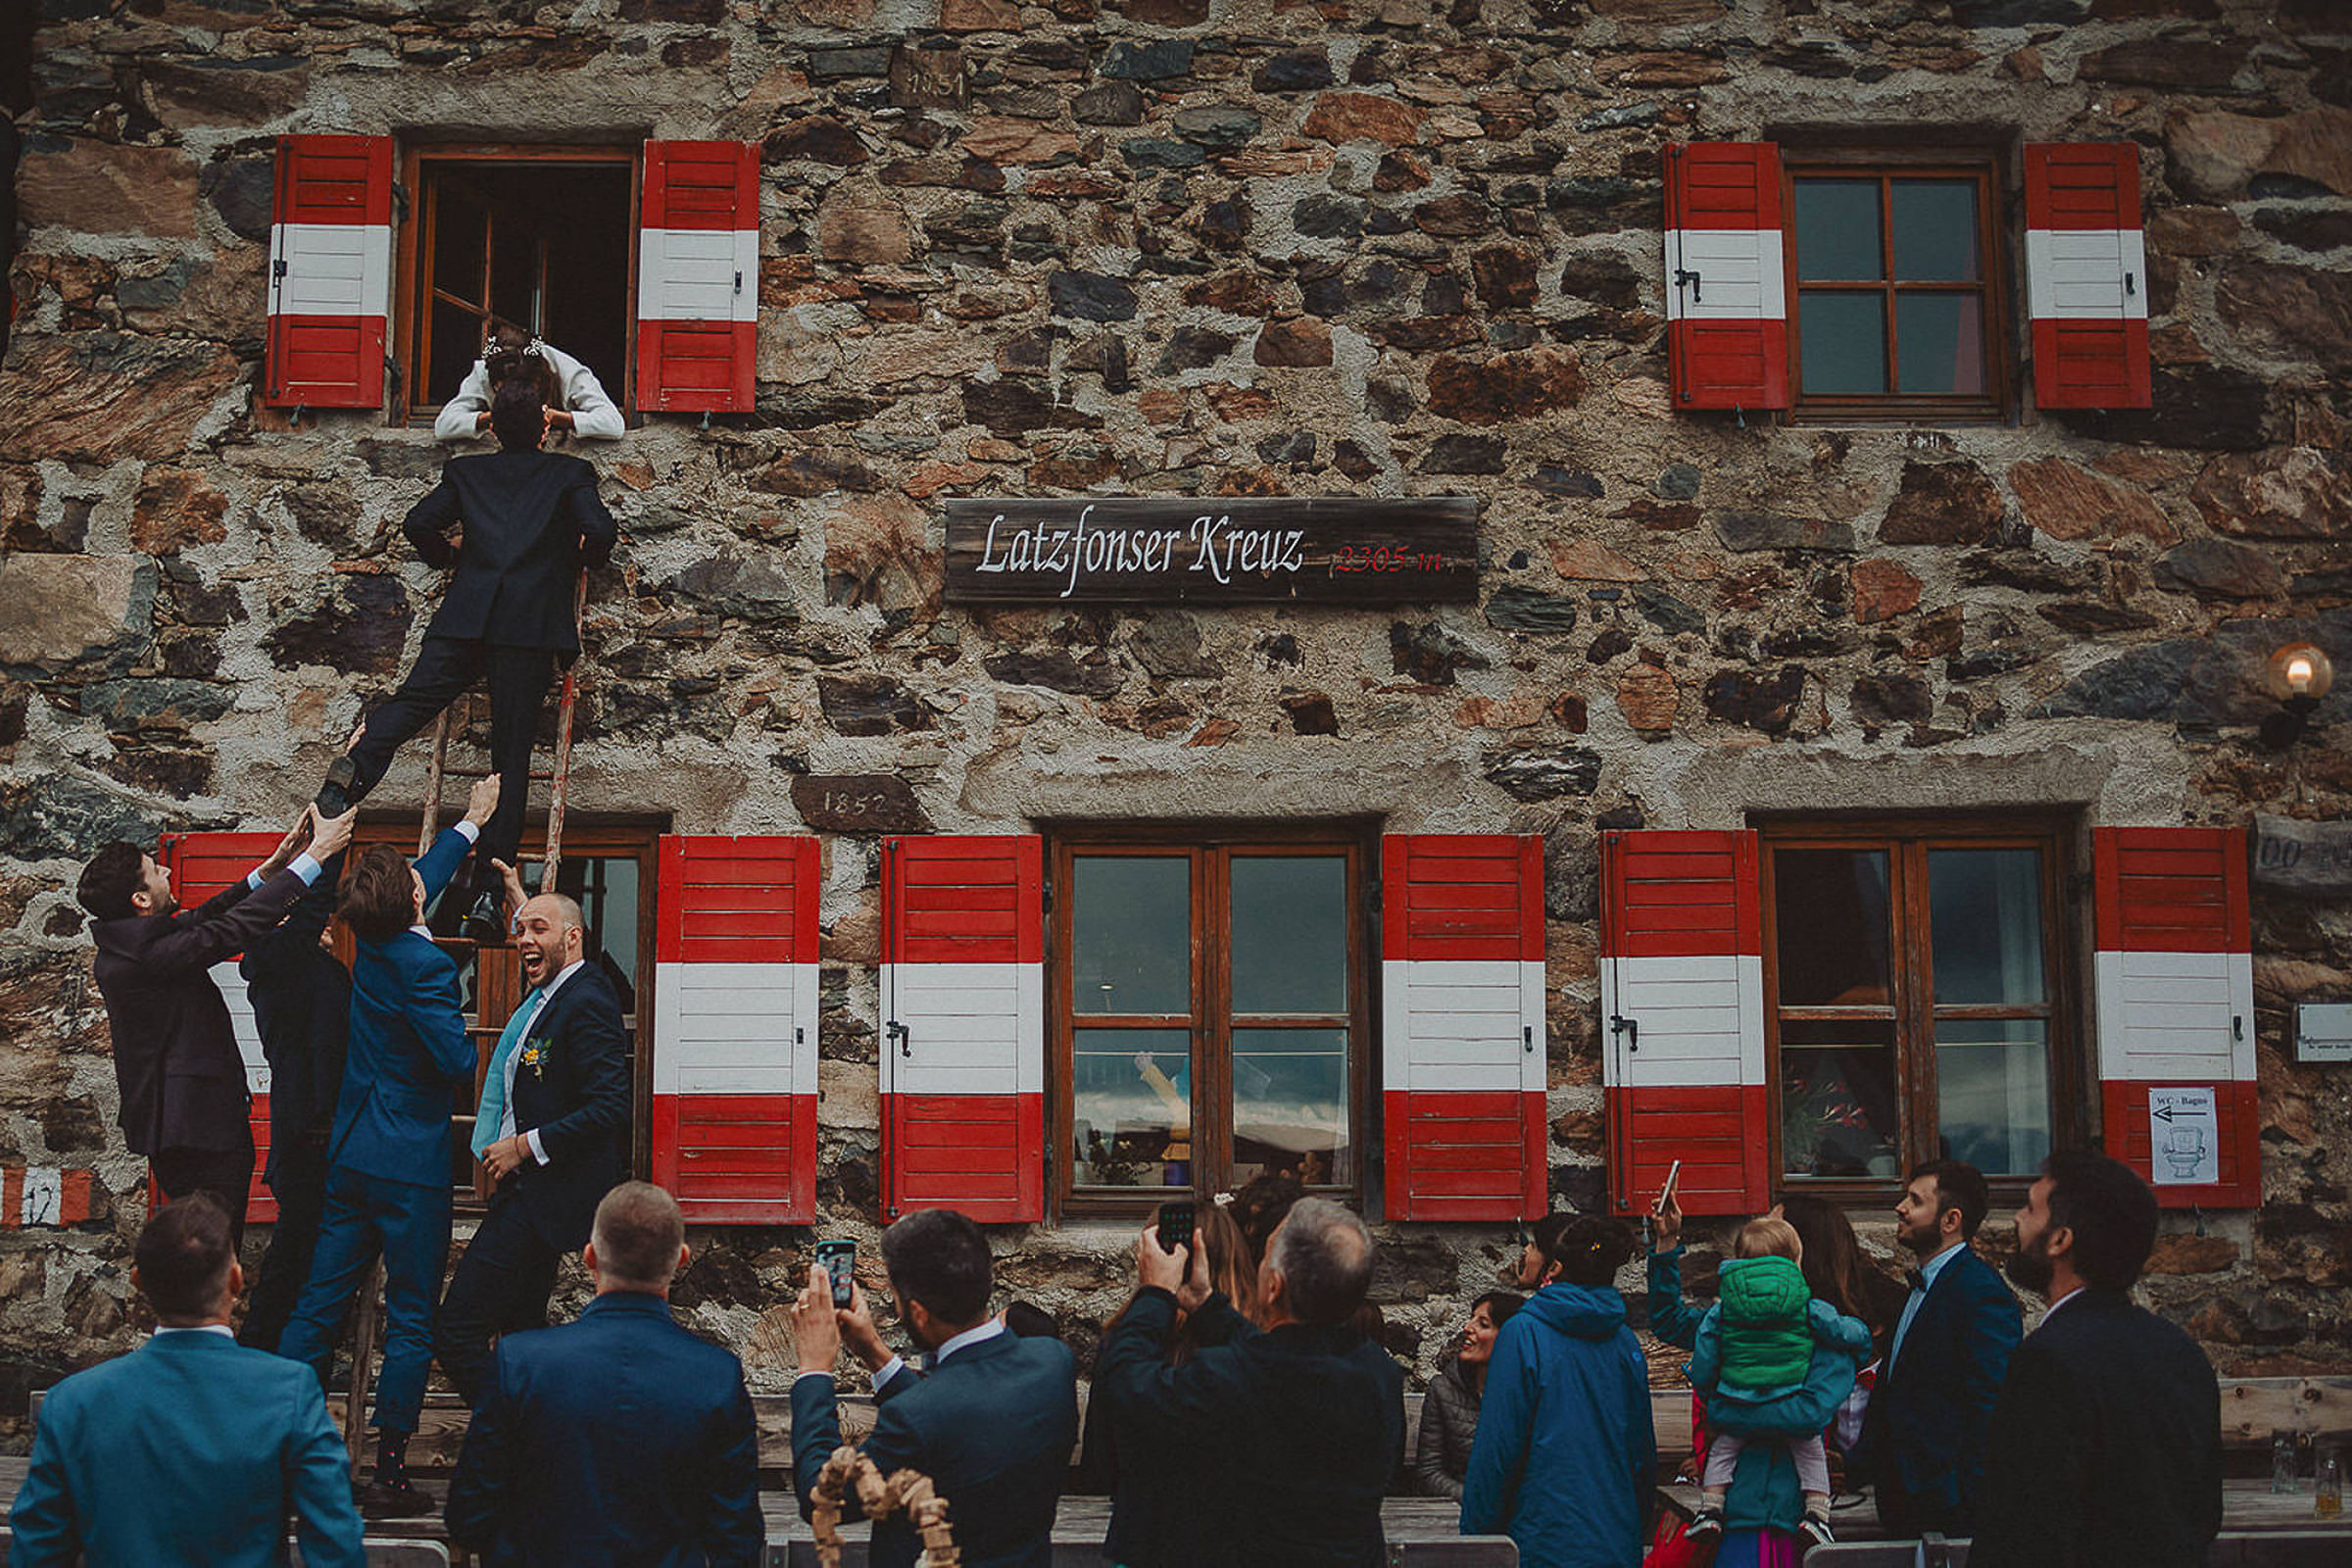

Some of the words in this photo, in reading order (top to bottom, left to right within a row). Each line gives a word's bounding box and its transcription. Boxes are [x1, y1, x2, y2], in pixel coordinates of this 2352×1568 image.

[976, 505, 1180, 598] Latzfonser
[1189, 515, 1303, 584] Kreuz
[1335, 546, 1409, 572] 2305
[1417, 553, 1443, 572] m
